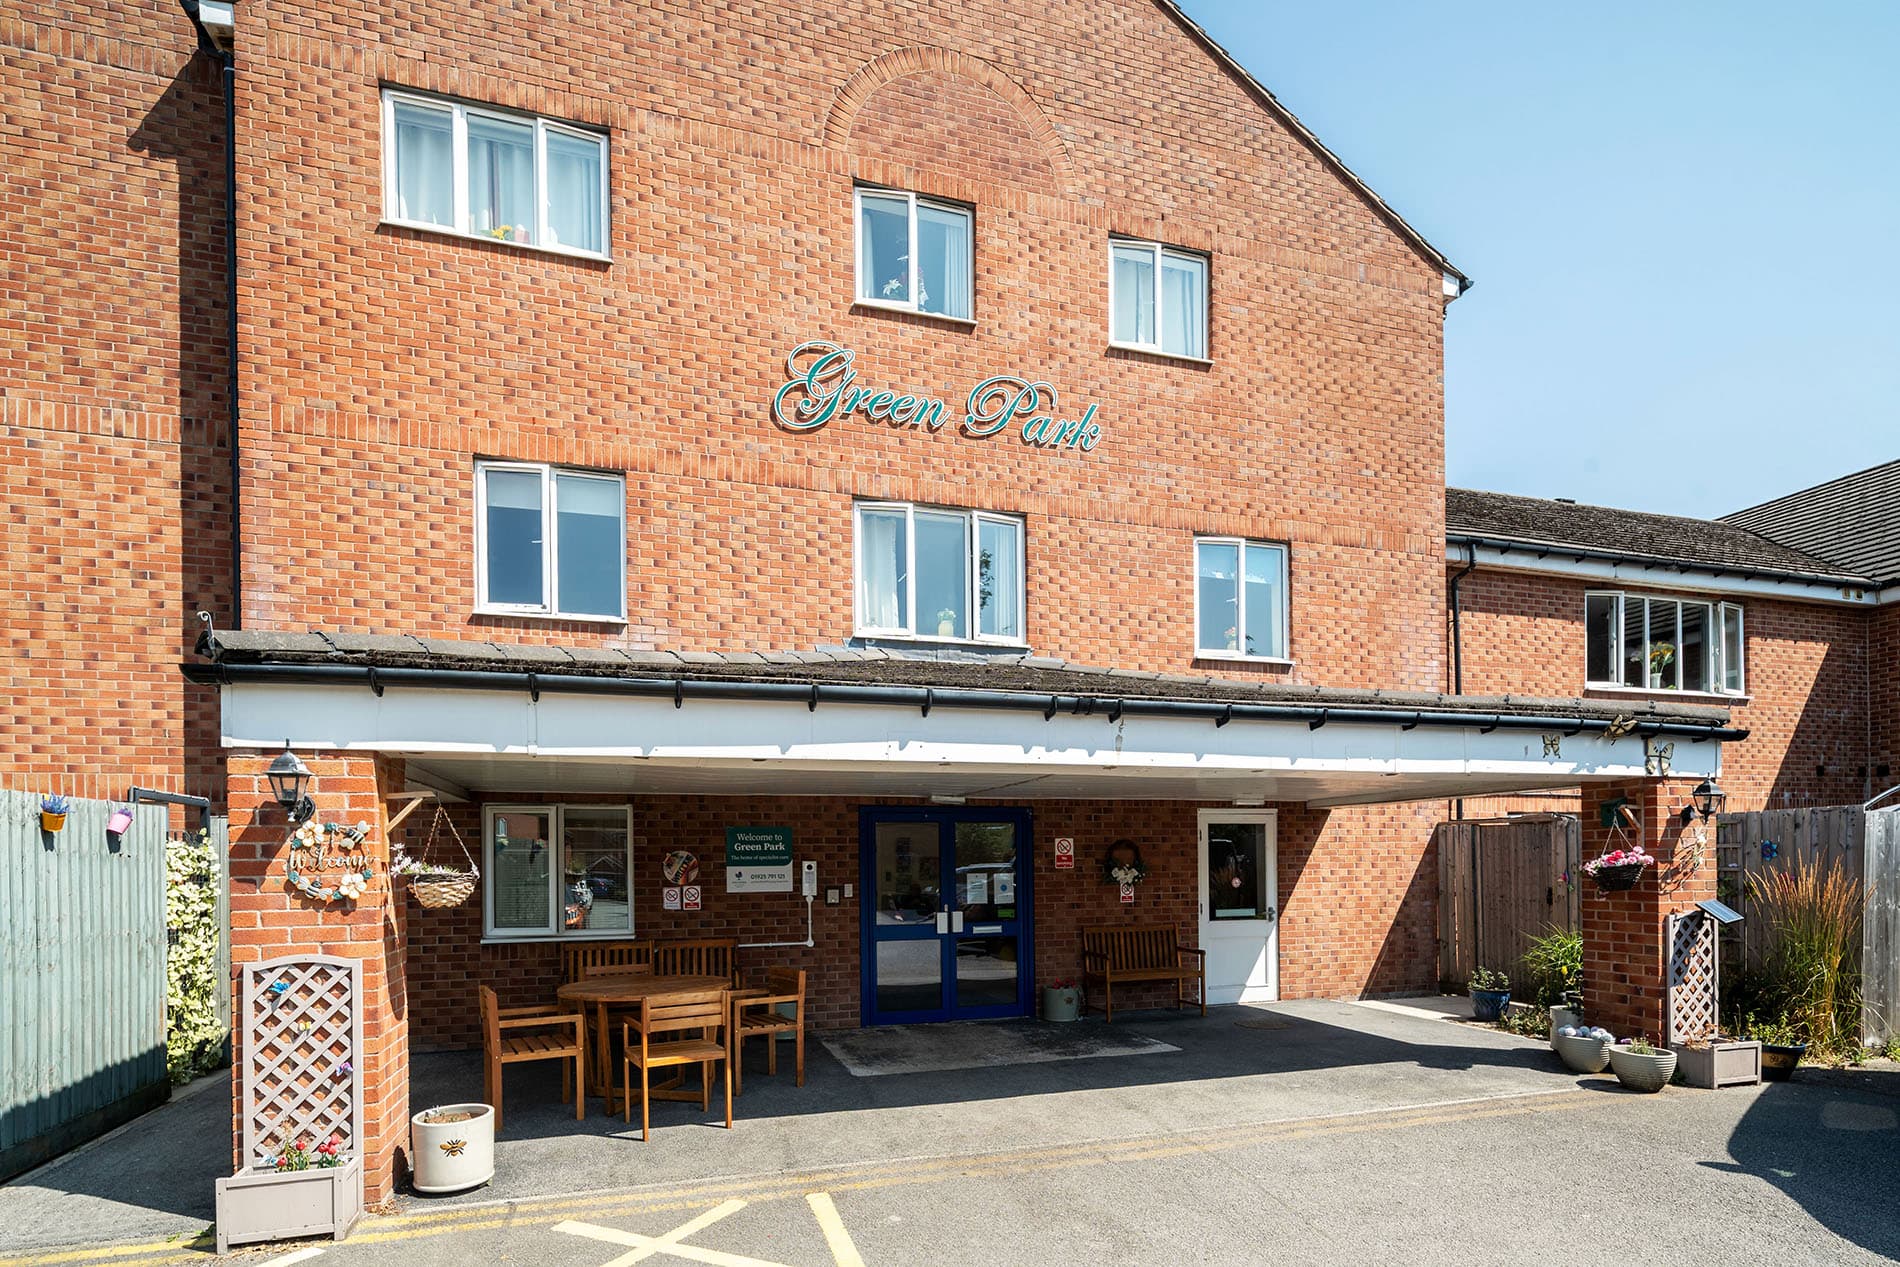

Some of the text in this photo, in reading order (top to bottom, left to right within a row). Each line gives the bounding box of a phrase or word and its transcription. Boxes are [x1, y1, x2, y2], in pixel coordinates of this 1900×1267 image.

[774, 340, 1102, 451] Green Park
[736, 833, 783, 841] Welcome to
[734, 842, 785, 851] Green Park
